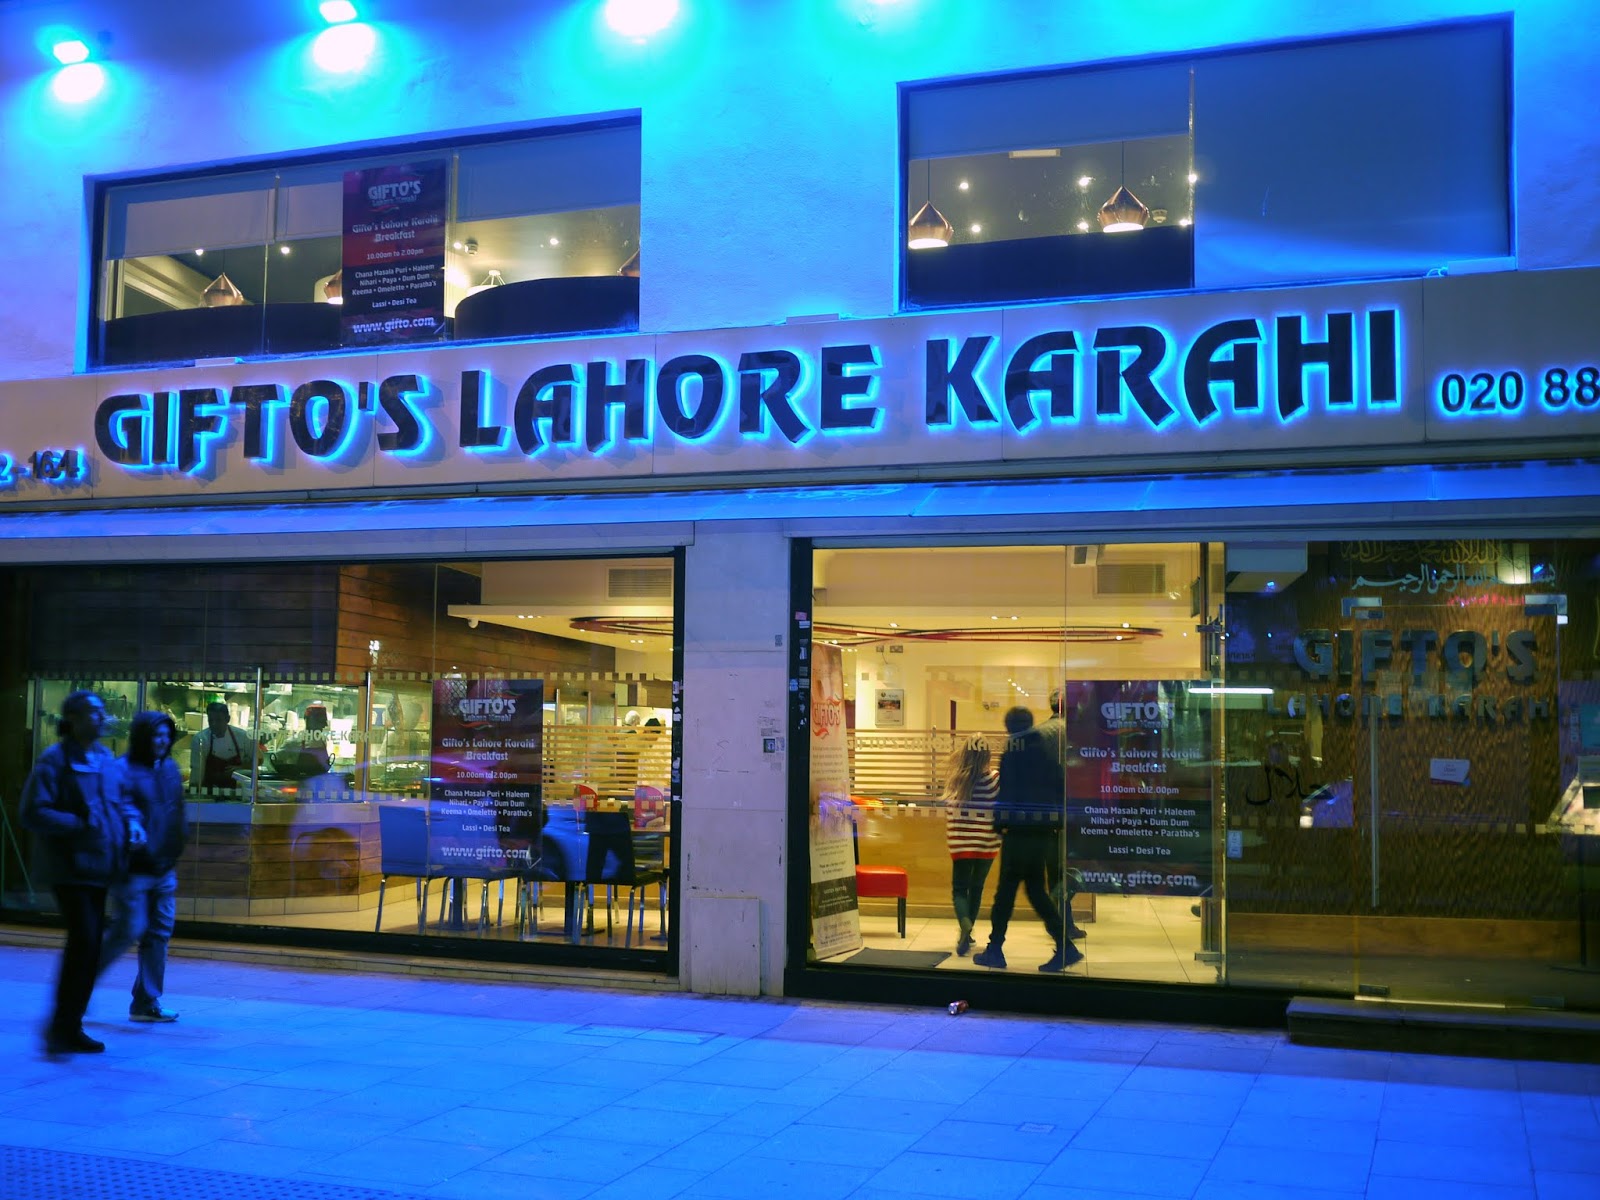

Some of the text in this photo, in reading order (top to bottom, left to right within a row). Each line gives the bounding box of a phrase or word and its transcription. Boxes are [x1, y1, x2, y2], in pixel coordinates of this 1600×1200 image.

[368, 180, 421, 200] GIFTO'S
[352, 215, 438, 233] Gifto's Lahore Karahi
[375, 230, 415, 242] Breakfast
[367, 250, 392, 260] 10.00am
[401, 248, 424, 257] 2.00pm
[355, 264, 435, 279] Chana Masala Puri Haleem
[360, 273, 430, 286] Nihari Paya Dum Dum
[352, 281, 437, 296] Keema Omelette Paratha's
[372, 300, 387, 308] Lassi
[352, 316, 435, 334] www.gifto.com
[94, 309, 1401, 477] GIFTO'S LAHORE KARAHI
[1441, 371, 1524, 412] 020
[1293, 628, 1538, 685] GIFTO'S
[459, 698, 516, 715] GIFTO'S
[1100, 702, 1175, 721] GIFTO'S
[1427, 694, 1554, 721] KARAH
[442, 738, 535, 748] Gifto's Lahore Karahi
[464, 751, 509, 761] Breakfast
[1080, 747, 1202, 759] Gifto's Lahore Karahi
[1110, 762, 1167, 773] Breakfast
[456, 771, 485, 779] 10.00am
[493, 772, 517, 780] 2.00pm
[1100, 786, 1136, 794] 10.00am
[1148, 786, 1179, 795] 2.00pm
[473, 799, 488, 807] Paya
[467, 808, 497, 816] Omelette
[502, 809, 532, 817] Paratha's
[1084, 806, 1196, 816] Chana Masala Puri Haleem
[1091, 817, 1189, 827] Nihari Paya Dum Dum
[1081, 827, 1200, 838] Keema Omelette Paratha's
[441, 845, 530, 860] www.gifto.com
[1109, 846, 1171, 855] Lassi Desi Tea
[1083, 870, 1198, 887] www.gifto.com
